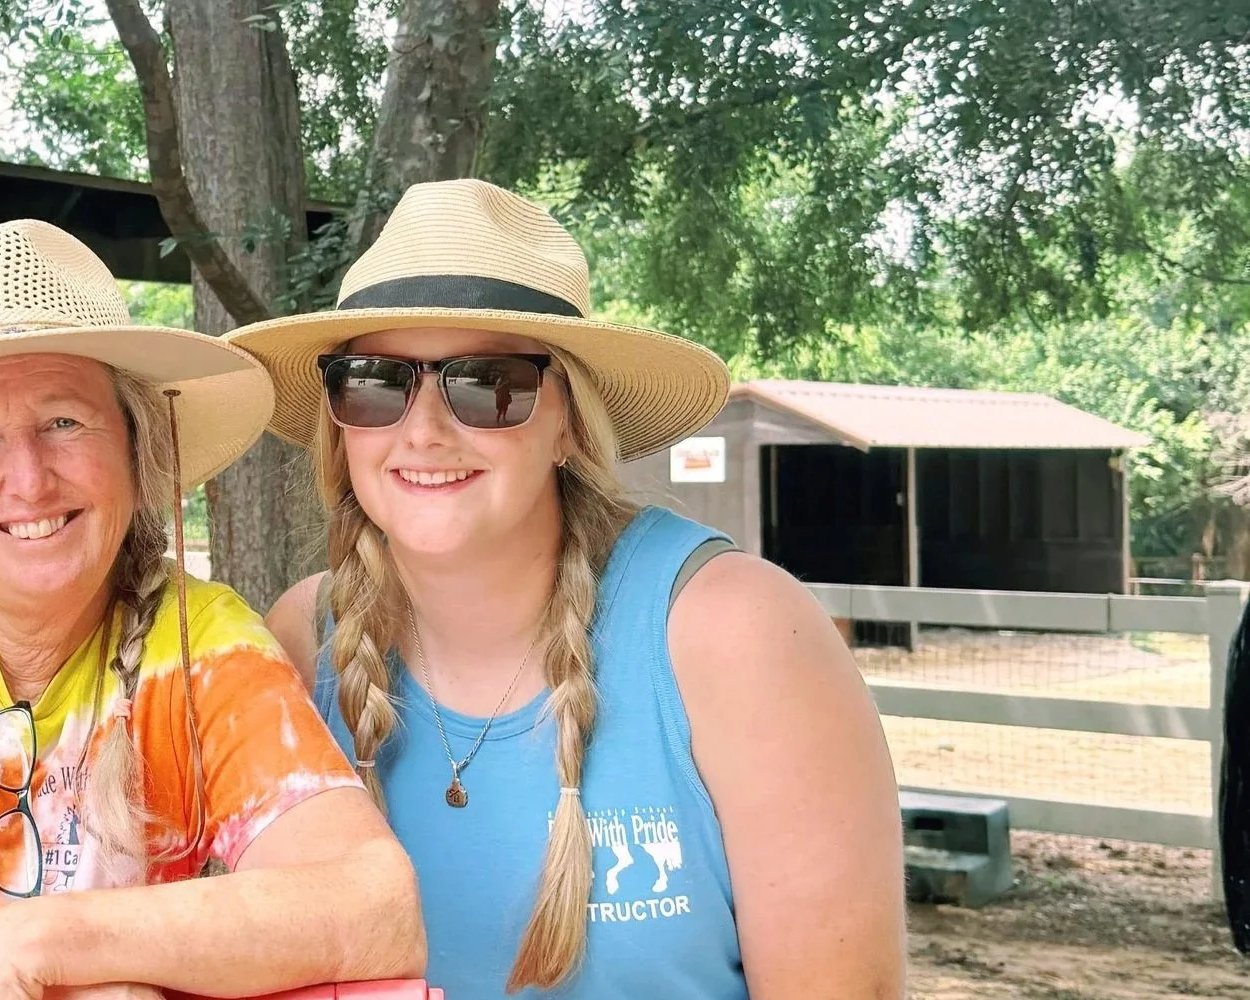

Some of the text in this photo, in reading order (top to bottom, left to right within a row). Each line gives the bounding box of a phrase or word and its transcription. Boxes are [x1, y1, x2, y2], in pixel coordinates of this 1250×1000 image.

[587, 815, 627, 847] With
[631, 812, 679, 845] Pride
[45, 849, 60, 865] #1
[586, 895, 691, 922] TRUCTOR
